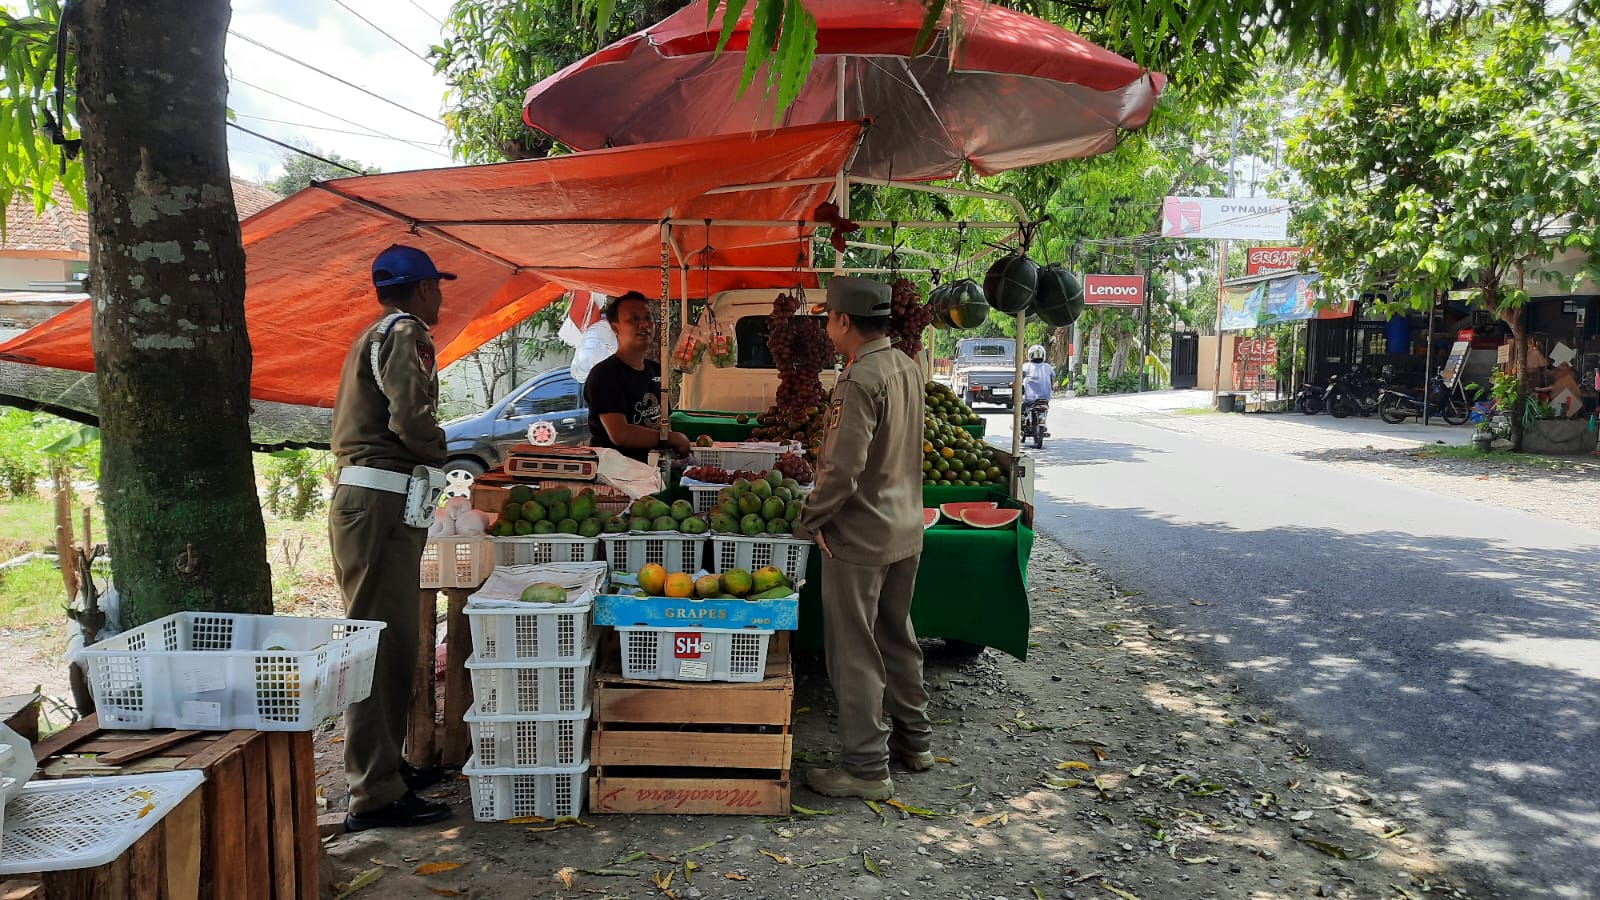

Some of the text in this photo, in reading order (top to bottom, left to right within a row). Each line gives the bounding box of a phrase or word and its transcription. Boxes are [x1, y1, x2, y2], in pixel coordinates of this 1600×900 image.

[1089, 284, 1138, 296] Lenovo
[664, 607, 727, 620] GRAPES
[675, 636, 701, 654] SH
